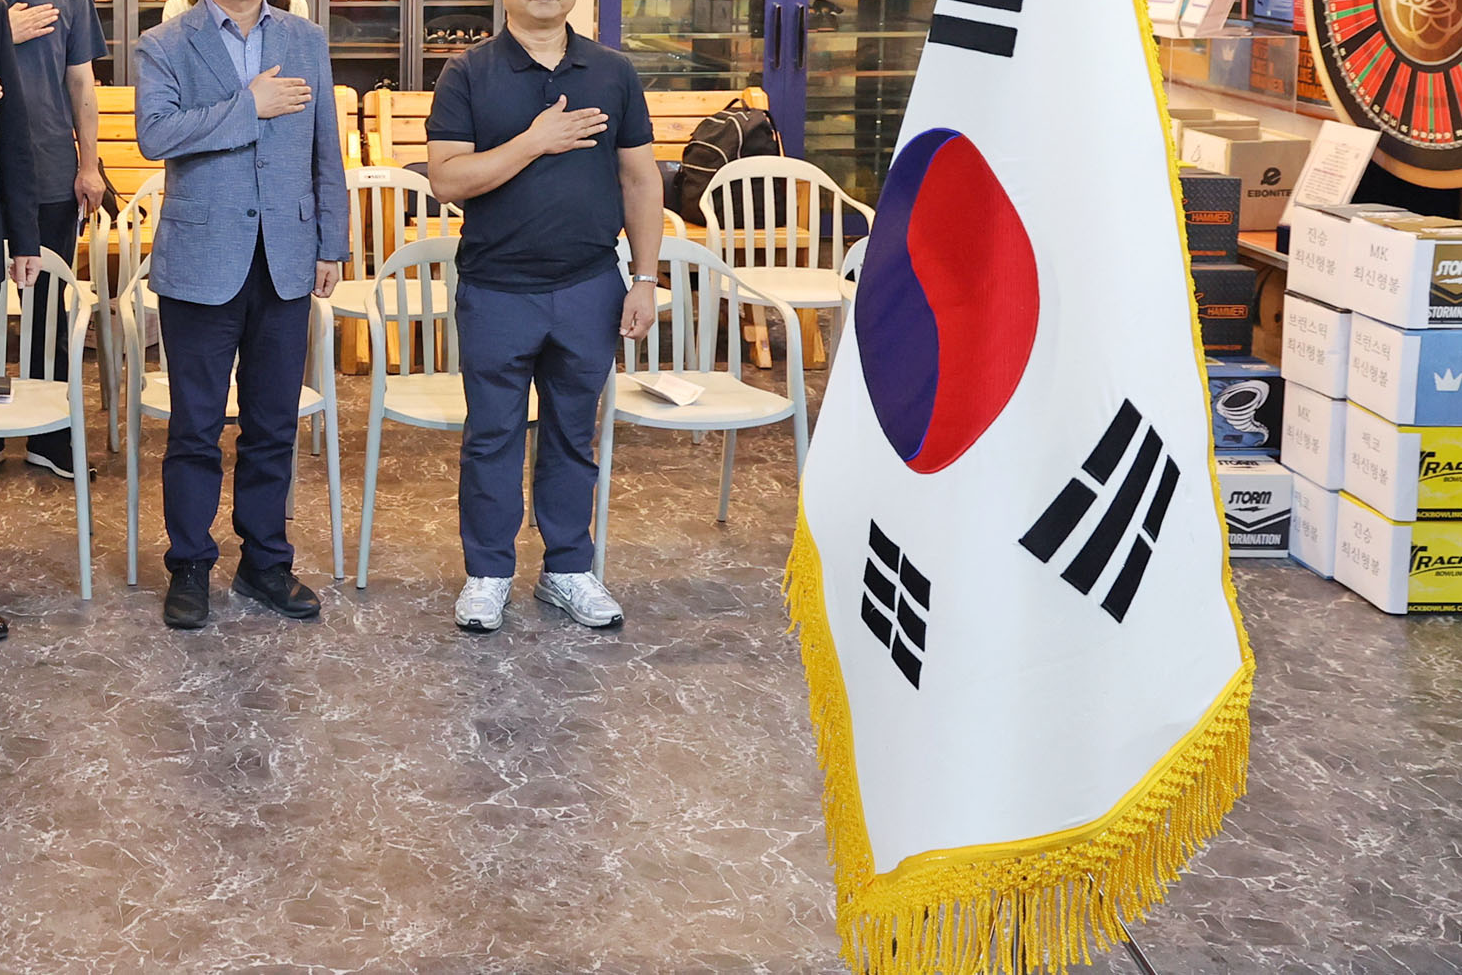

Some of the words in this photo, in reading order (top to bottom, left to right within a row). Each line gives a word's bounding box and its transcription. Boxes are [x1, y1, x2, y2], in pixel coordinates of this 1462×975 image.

[1247, 188, 1293, 198] EBONITE
[1191, 212, 1230, 223] HAMMER
[1207, 307, 1246, 316] HAMMER
[1228, 491, 1273, 505] STORM
